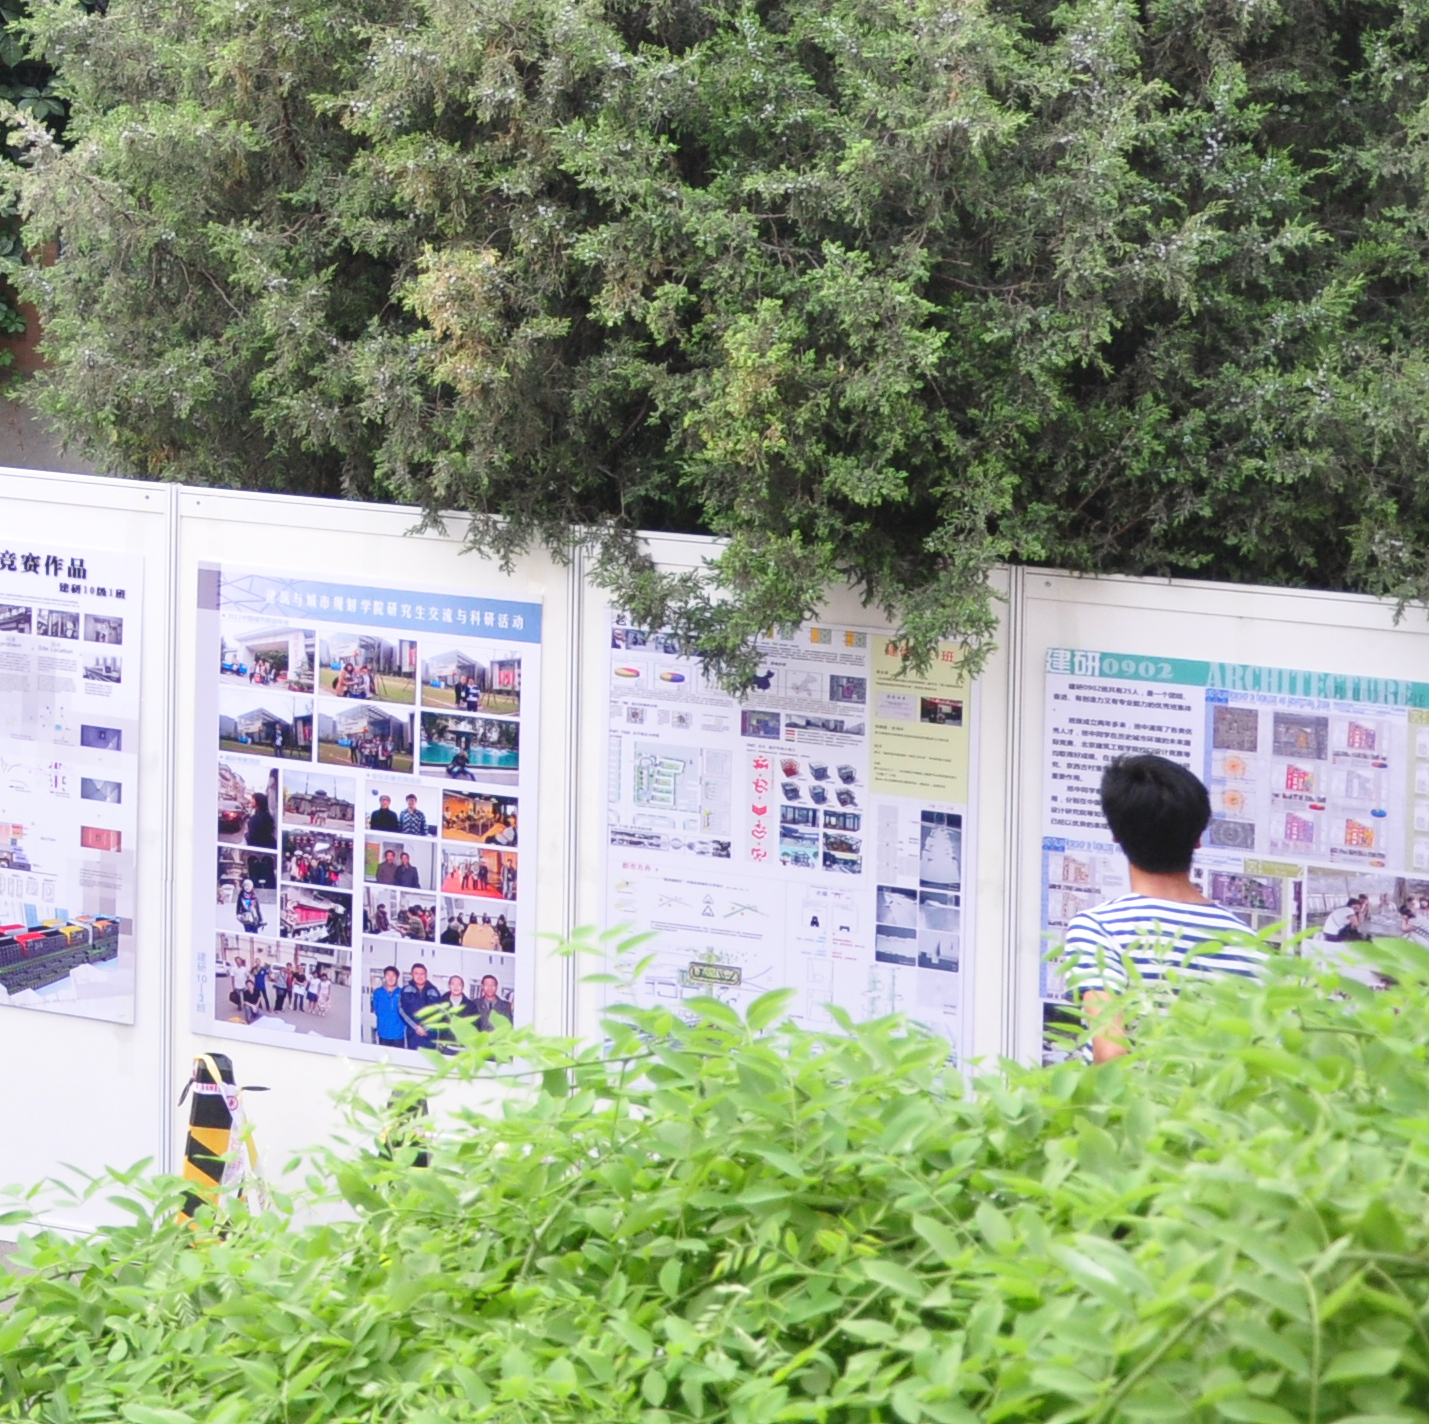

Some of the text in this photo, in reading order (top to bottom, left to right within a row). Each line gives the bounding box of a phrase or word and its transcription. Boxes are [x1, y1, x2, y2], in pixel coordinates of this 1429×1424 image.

[265, 589, 526, 631] 建筑与城市规划学院研究生交流与科研活动
[1206, 660, 1414, 708] ARCHITECTURE
